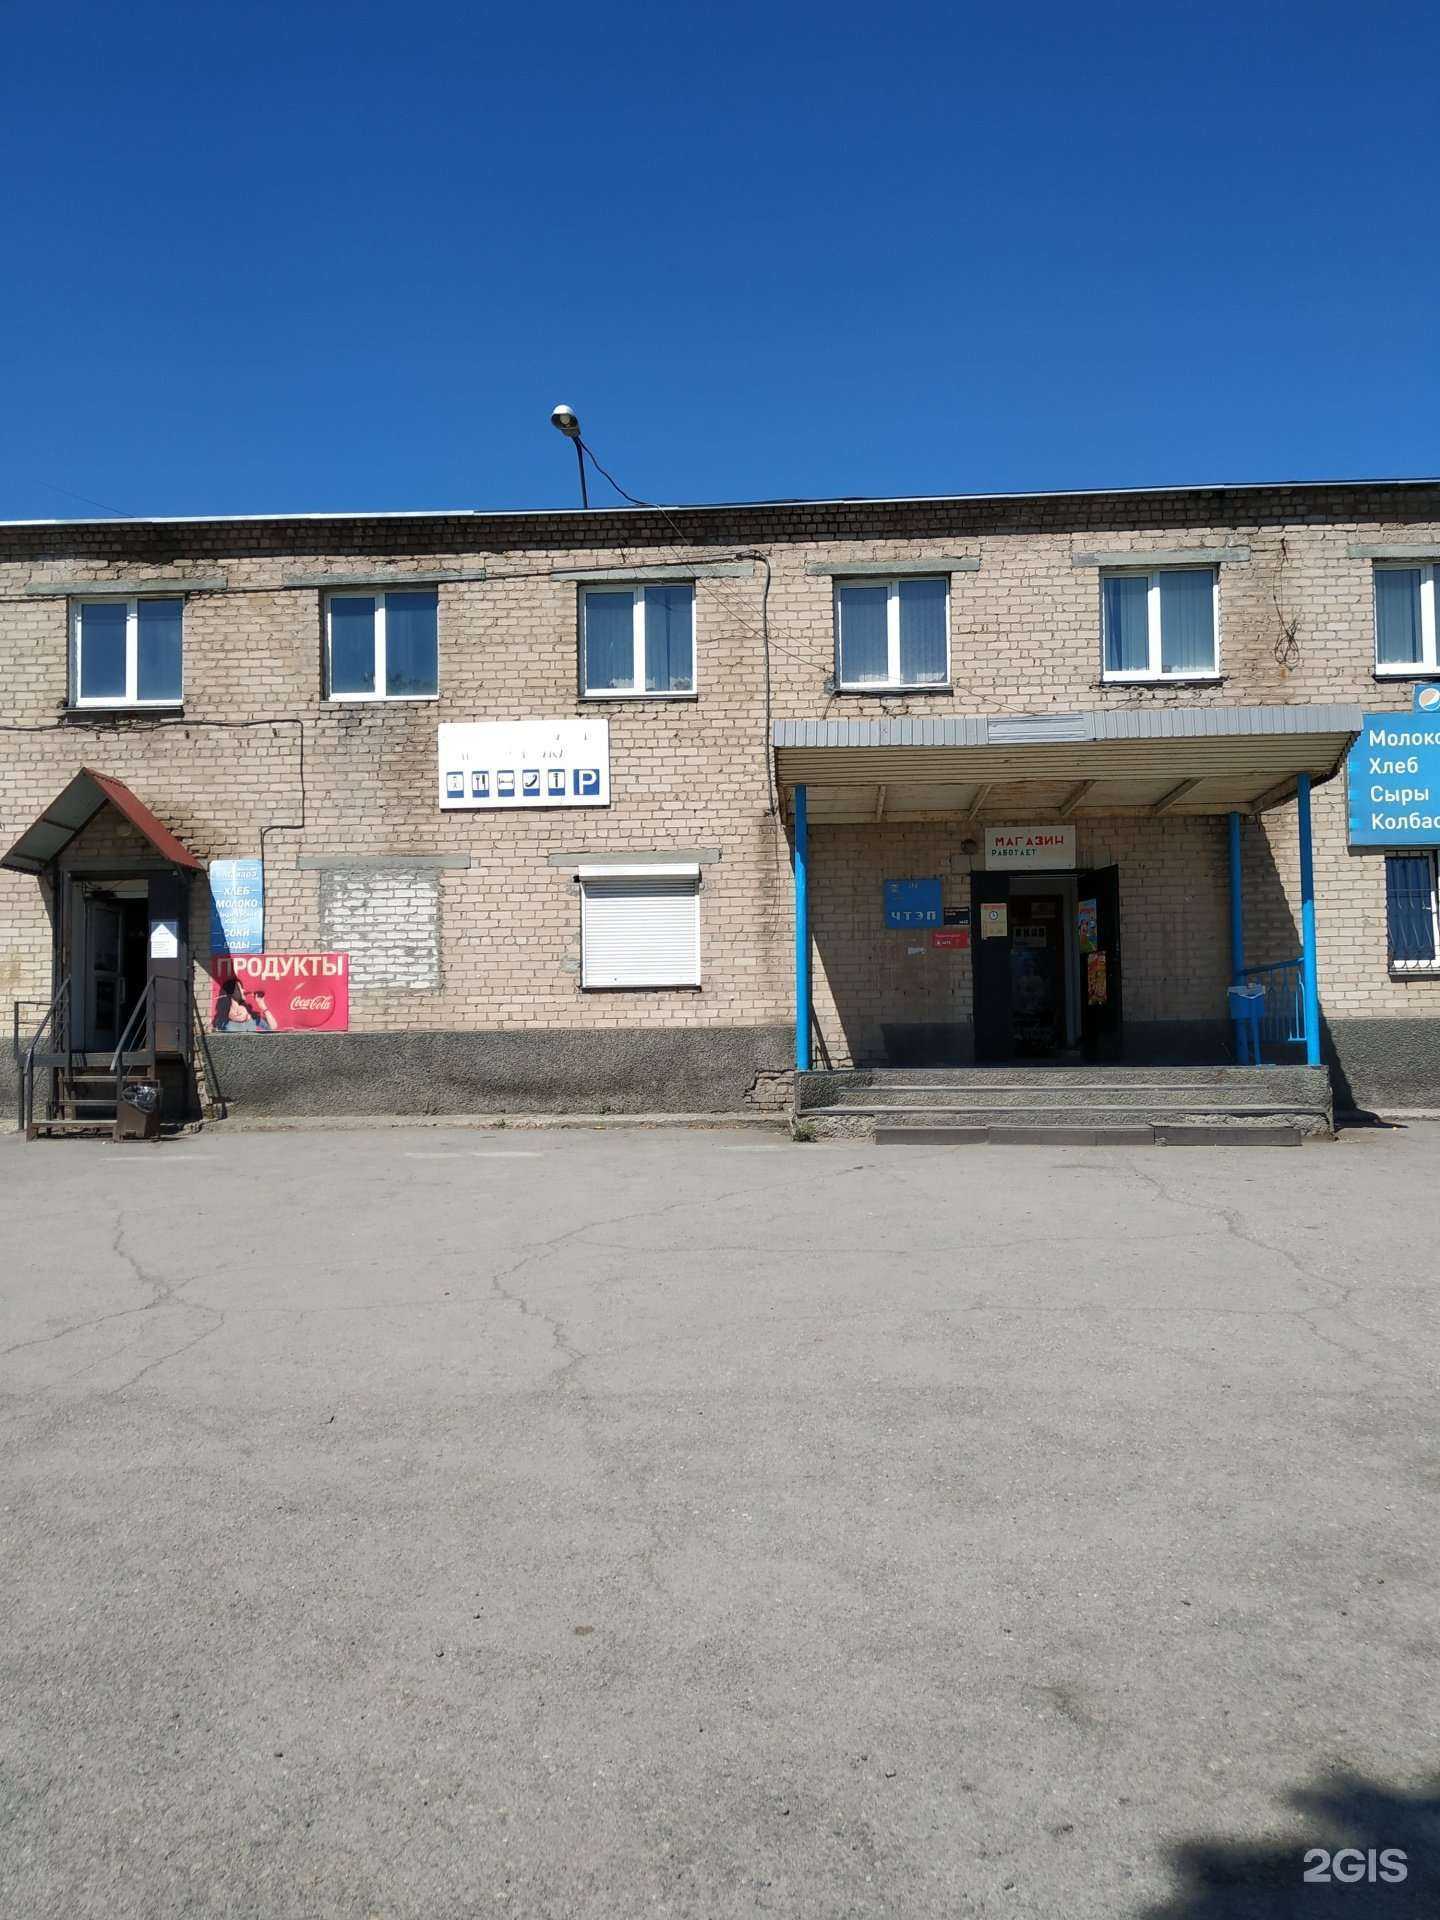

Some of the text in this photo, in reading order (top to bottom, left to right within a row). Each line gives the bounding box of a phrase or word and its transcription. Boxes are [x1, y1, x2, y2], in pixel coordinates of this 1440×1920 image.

[1369, 756, 1419, 774] Хлеб
[1370, 785, 1430, 806] Сыры
[995, 835, 1064, 847] МАГАЗИН
[991, 849, 1038, 857] РАБОТАЕТ
[223, 886, 250, 896] ХЛЕБ
[216, 897, 258, 908] МОЛОКО
[217, 956, 343, 981] ПРОДУКТЫ
